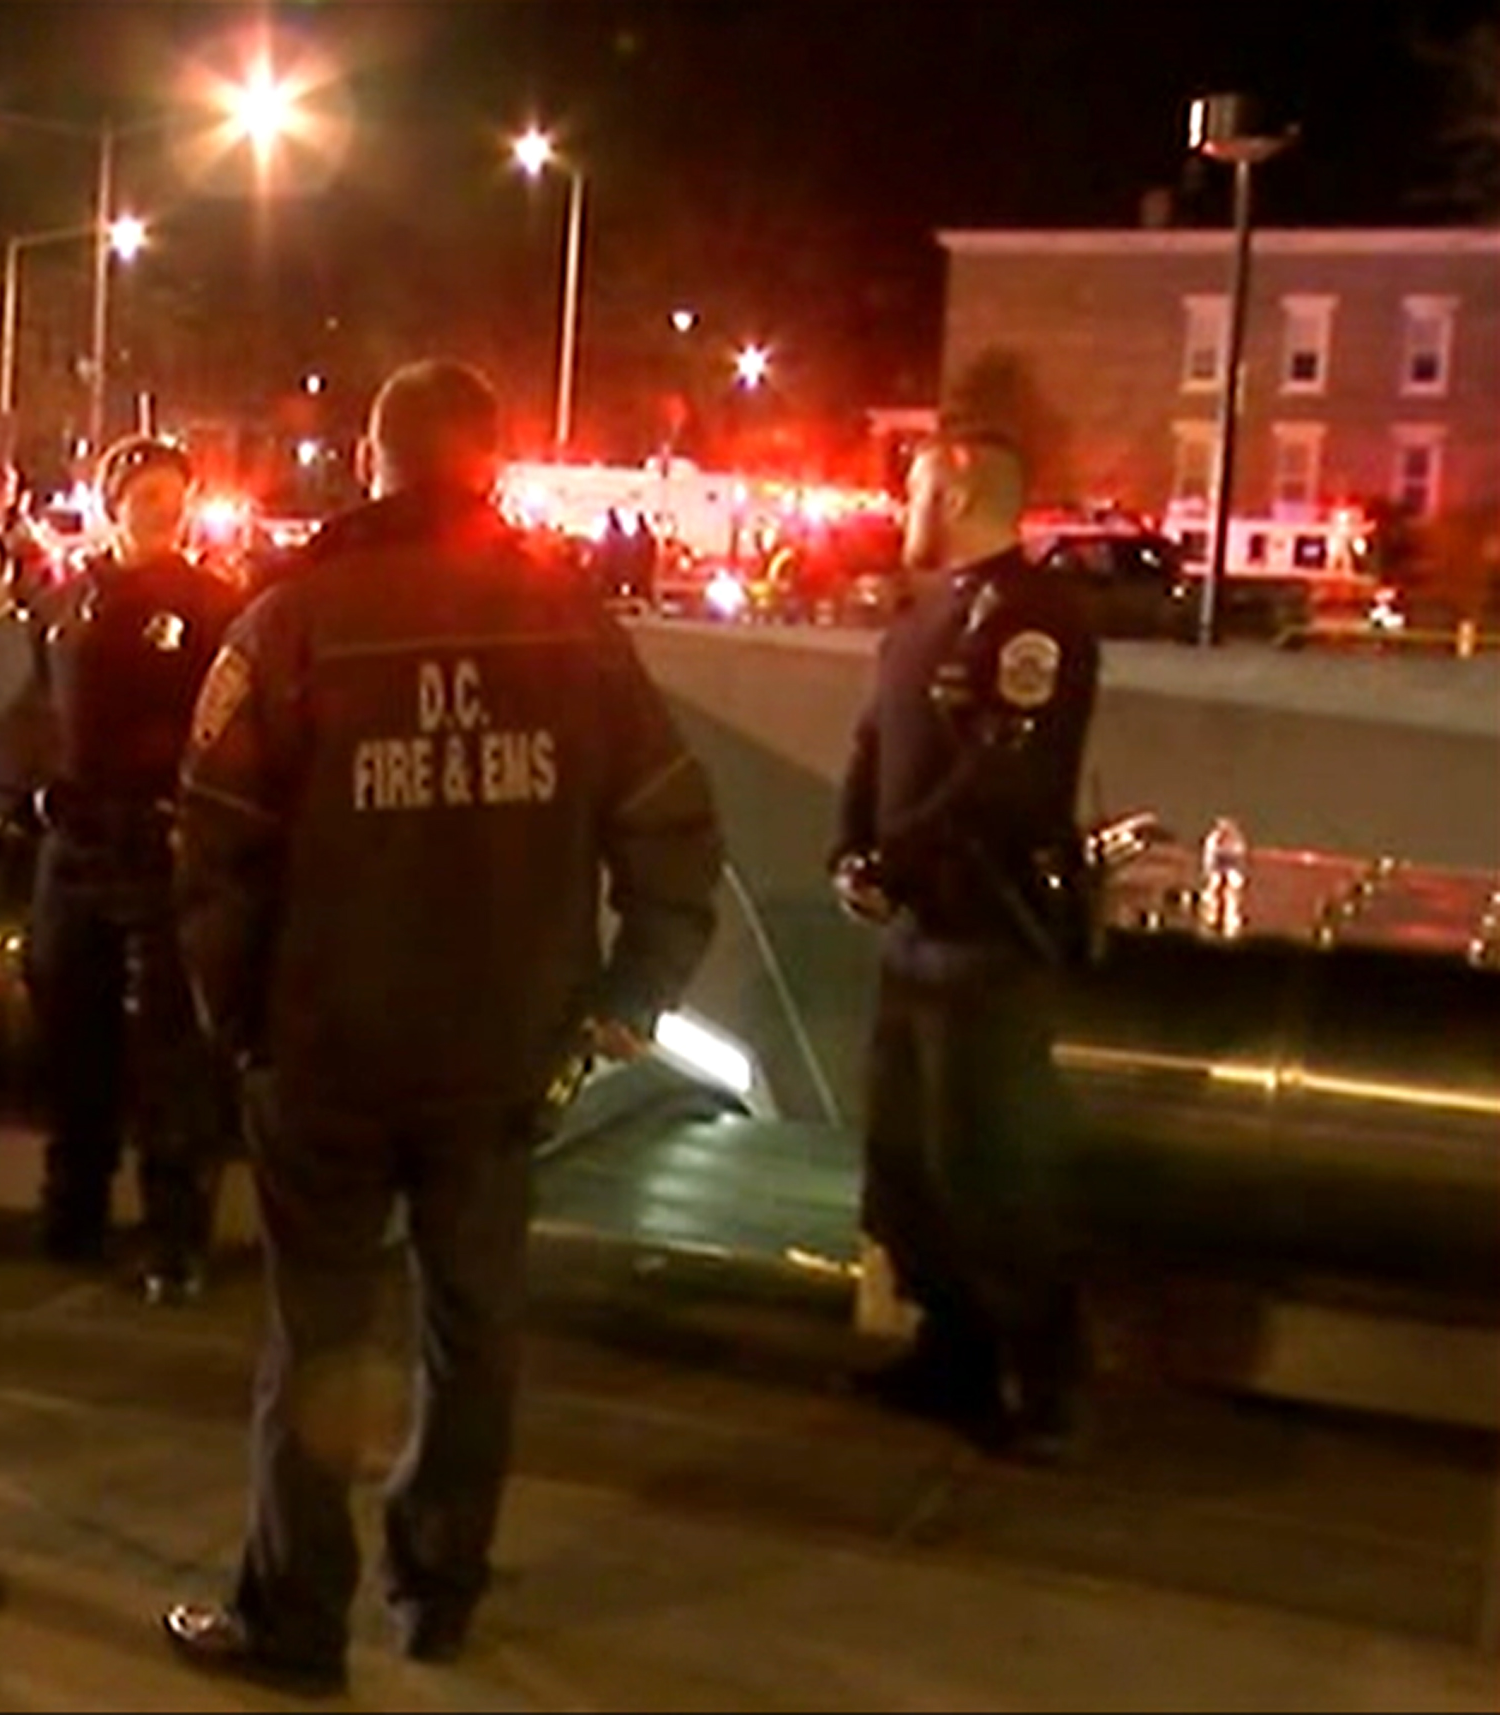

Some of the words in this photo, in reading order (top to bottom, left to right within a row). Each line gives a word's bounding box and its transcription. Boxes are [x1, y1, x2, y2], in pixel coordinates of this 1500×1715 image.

[418, 659, 491, 731] D.C.
[354, 738, 434, 810] FIRE
[444, 734, 474, 805] &
[481, 730, 557, 803] EMS
